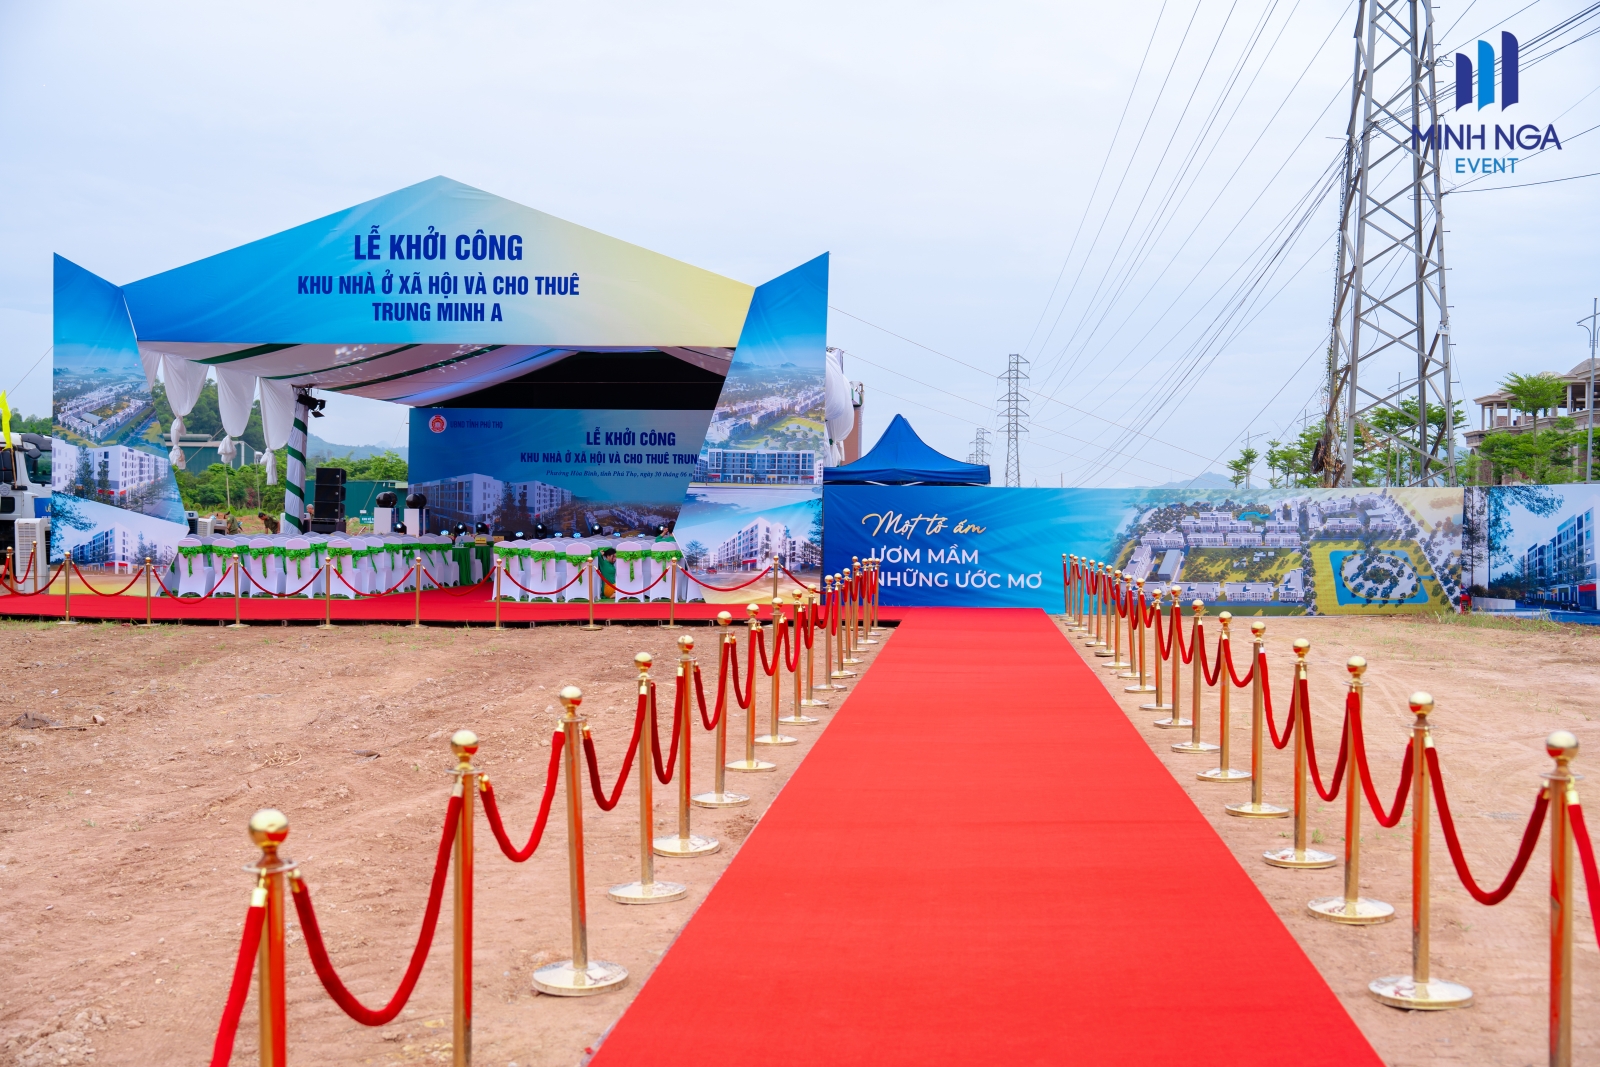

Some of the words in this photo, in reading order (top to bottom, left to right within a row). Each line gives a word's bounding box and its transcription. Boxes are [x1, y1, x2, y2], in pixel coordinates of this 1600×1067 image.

[354, 225, 381, 260] LỄ
[389, 225, 447, 260] KHỞI
[455, 229, 523, 261] CÔNG
[298, 276, 332, 294] KHU
[338, 272, 376, 294] NHÀ
[381, 269, 394, 295] Ở
[399, 272, 423, 295] XÃ
[429, 272, 458, 299] HỘI
[464, 272, 487, 295] VÀ
[493, 276, 529, 296] CHO
[535, 273, 580, 296] THUÊ
[372, 302, 431, 322] TRUNG
[437, 303, 484, 322] MINH
[490, 303, 503, 322] A
[586, 426, 601, 446] LỄ
[605, 427, 636, 446] KHỞI
[640, 429, 676, 446] CÔNG
[520, 452, 540, 463] KHU
[542, 450, 562, 463] NHÀ
[565, 449, 572, 463] Ở
[574, 450, 587, 464] XÃ
[589, 451, 606, 466] HỘI
[608, 451, 621, 464] VÀ
[623, 453, 643, 464] CHO
[645, 451, 670, 465] THUÊ
[672, 453, 699, 465] TRUN
[861, 510, 924, 540] Một
[871, 545, 920, 564] ƯƠM
[927, 543, 979, 565] MẦM
[955, 569, 1002, 588] ƯỚC
[1008, 571, 1043, 589] MƠ
